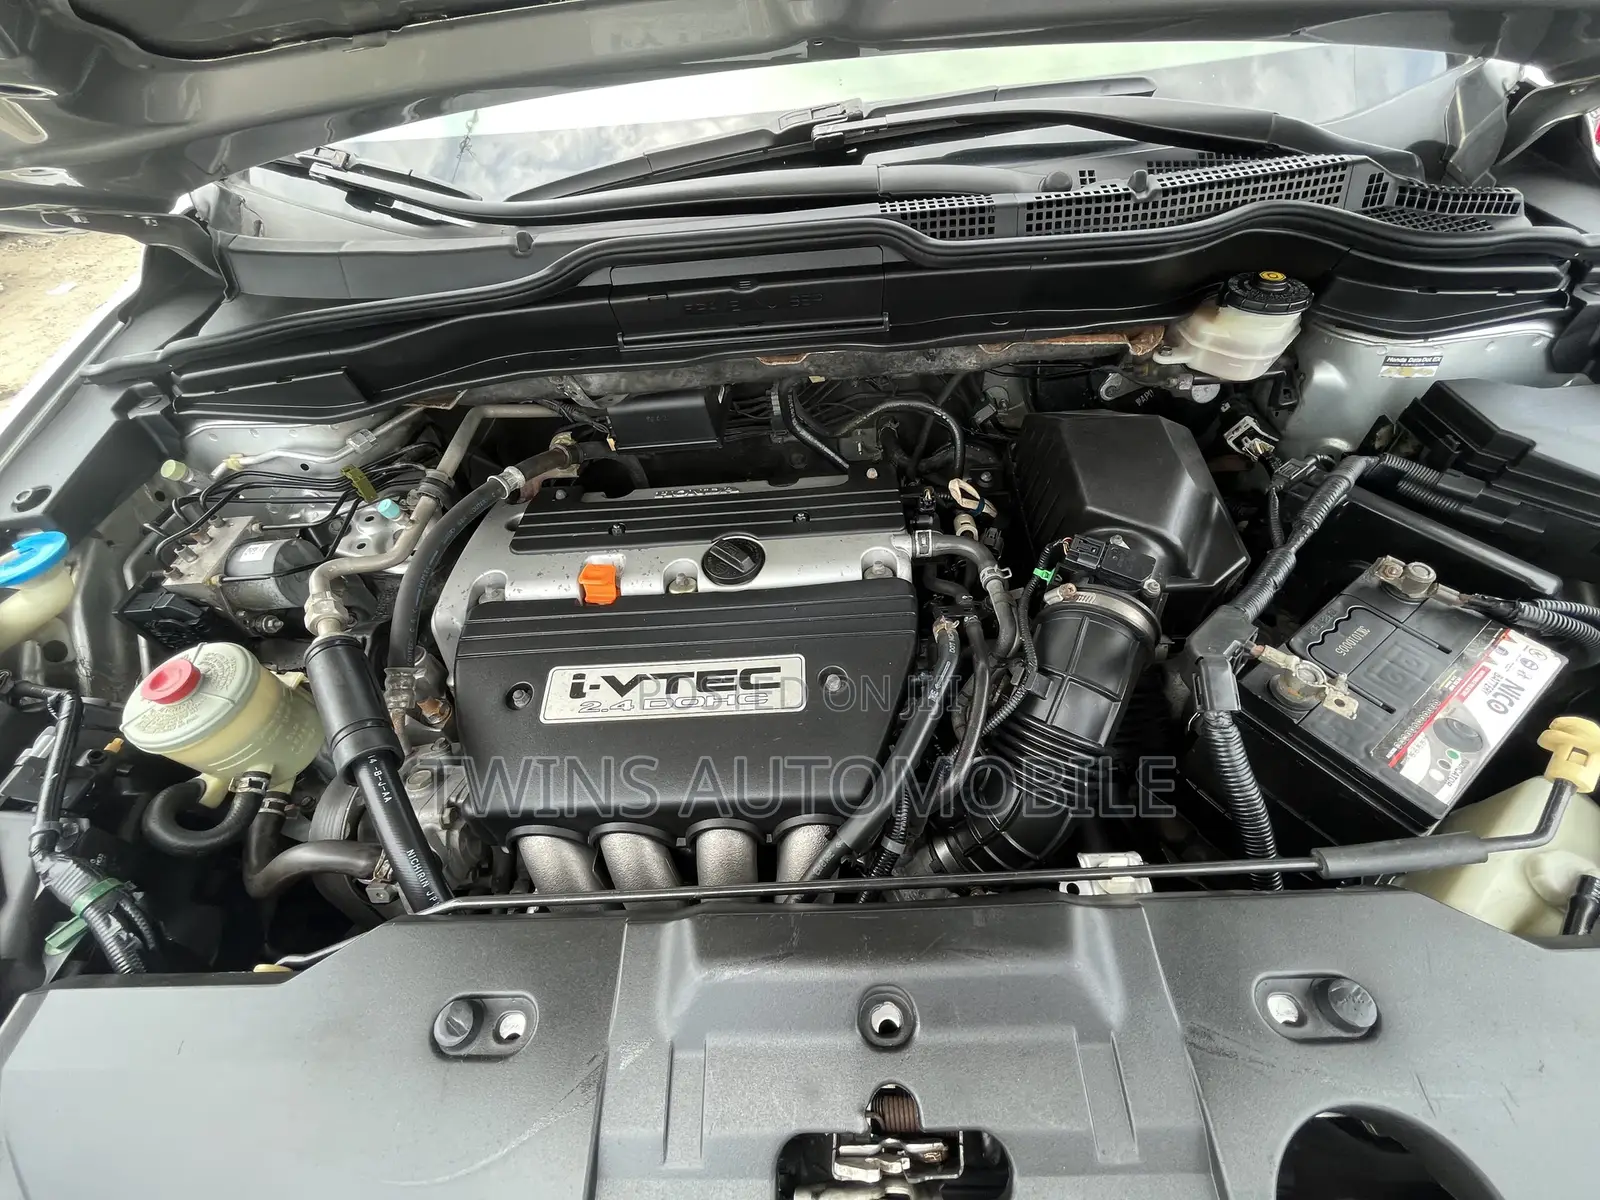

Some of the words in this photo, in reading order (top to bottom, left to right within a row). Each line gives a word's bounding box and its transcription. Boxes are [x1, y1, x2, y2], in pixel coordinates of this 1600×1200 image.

[569, 666, 782, 699] i-VTEC
[1486, 678, 1526, 715] NICO
[577, 699, 635, 714] 2.4
[642, 692, 769, 711] DOHC
[406, 848, 430, 888] NICHIRIN
